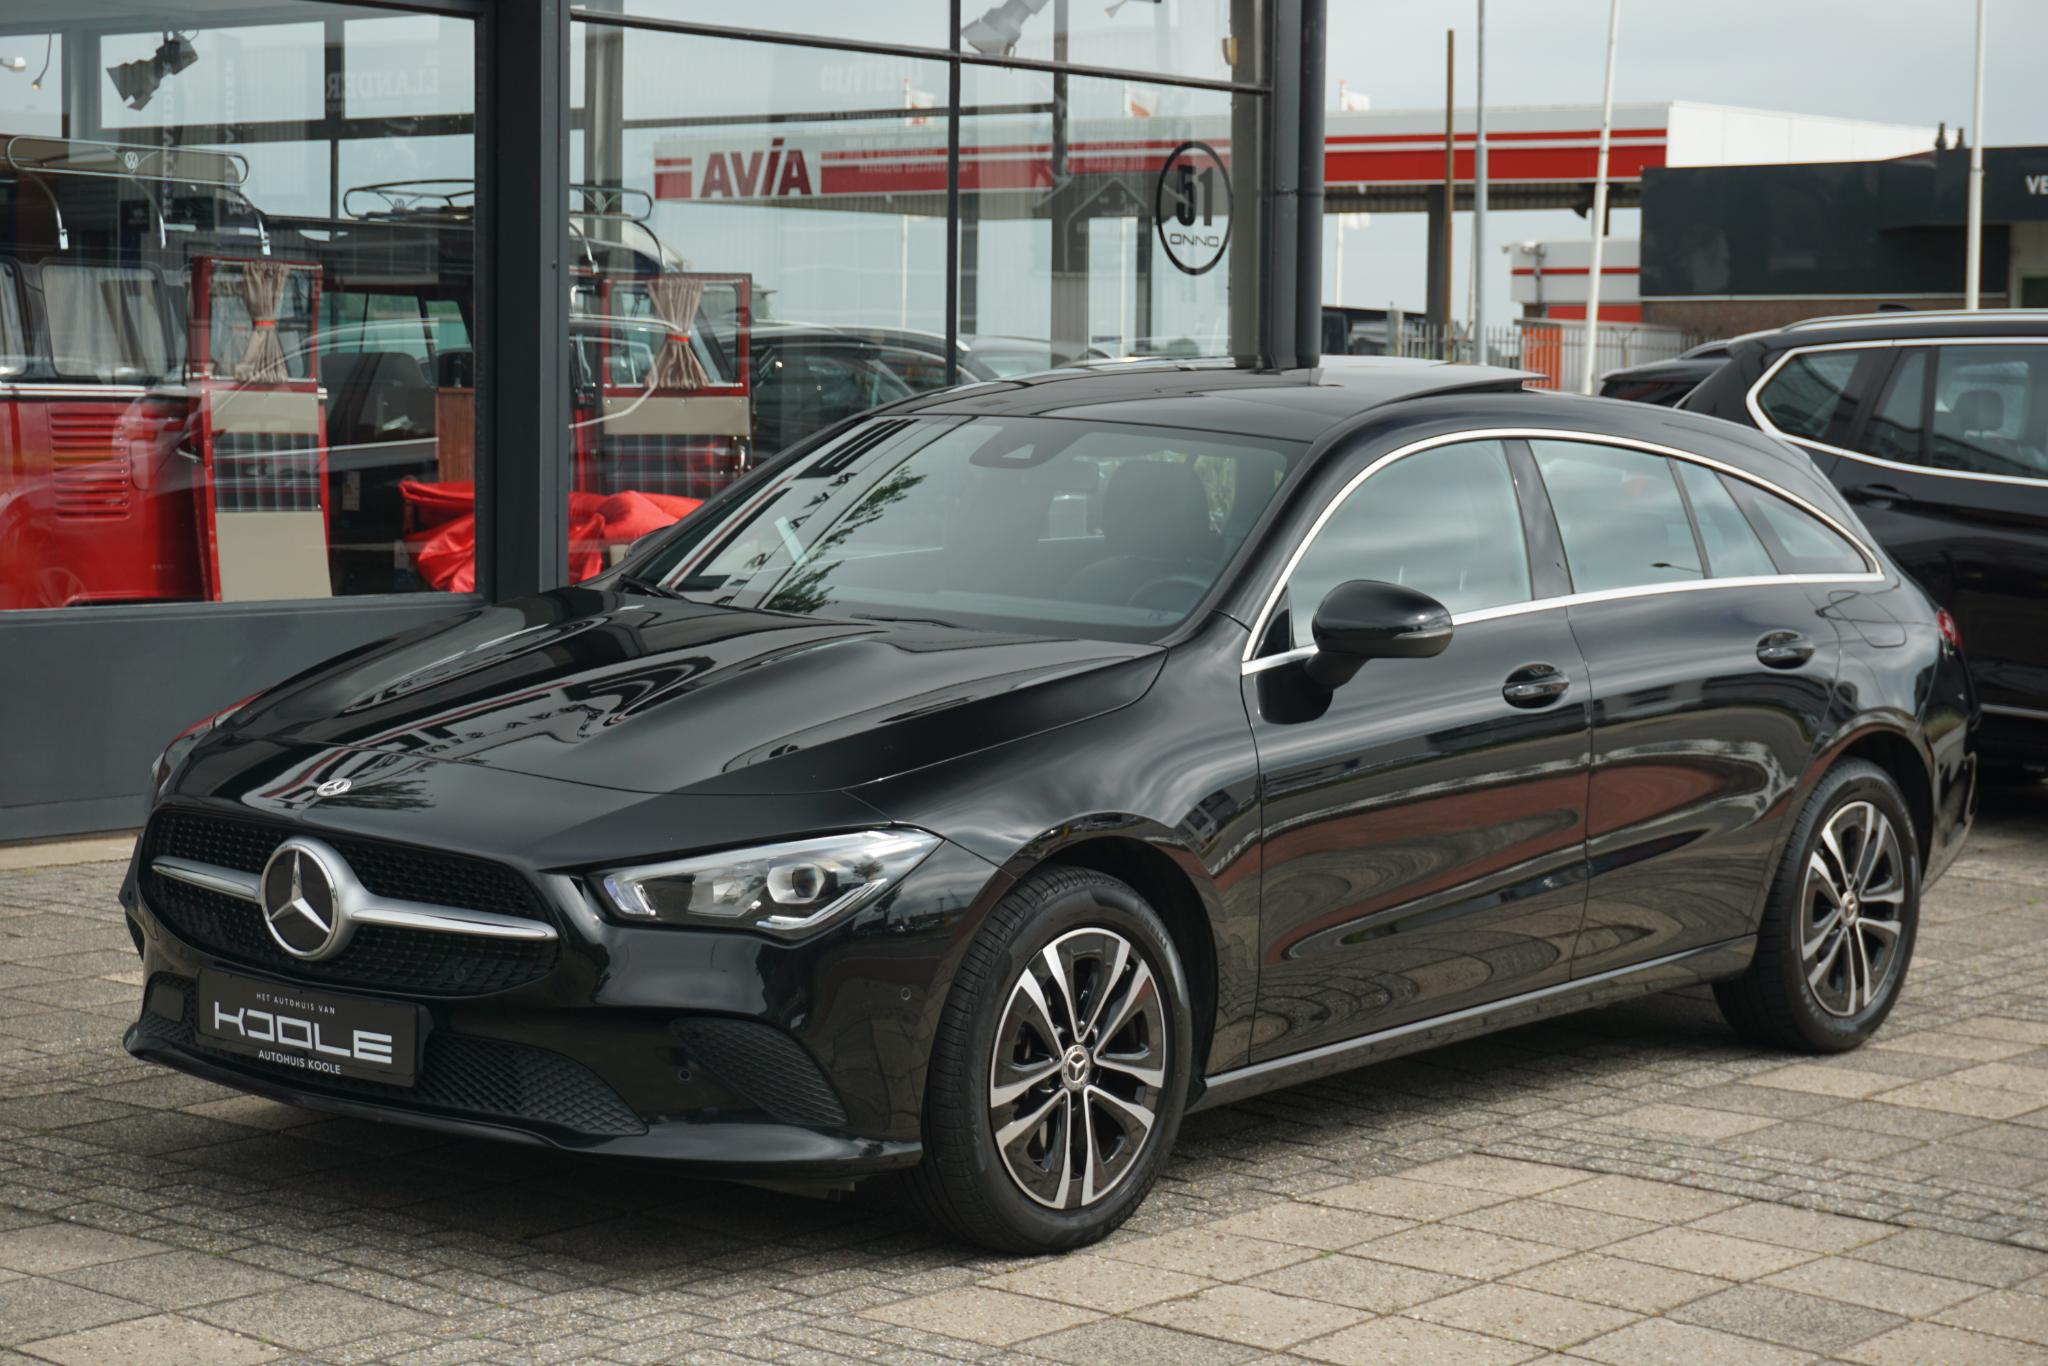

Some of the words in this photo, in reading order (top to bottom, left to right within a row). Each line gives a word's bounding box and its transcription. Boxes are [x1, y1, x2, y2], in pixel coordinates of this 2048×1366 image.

[1176, 164, 1214, 226] 51
[1169, 233, 1219, 248] ONNO
[256, 992, 271, 1002] HET
[273, 996, 315, 1011] AUTOHUIS
[318, 1005, 336, 1015] VAN
[214, 1001, 393, 1064] KOOLE
[258, 1049, 305, 1068] AUTOHUIS
[308, 1060, 341, 1074] KOOLE
